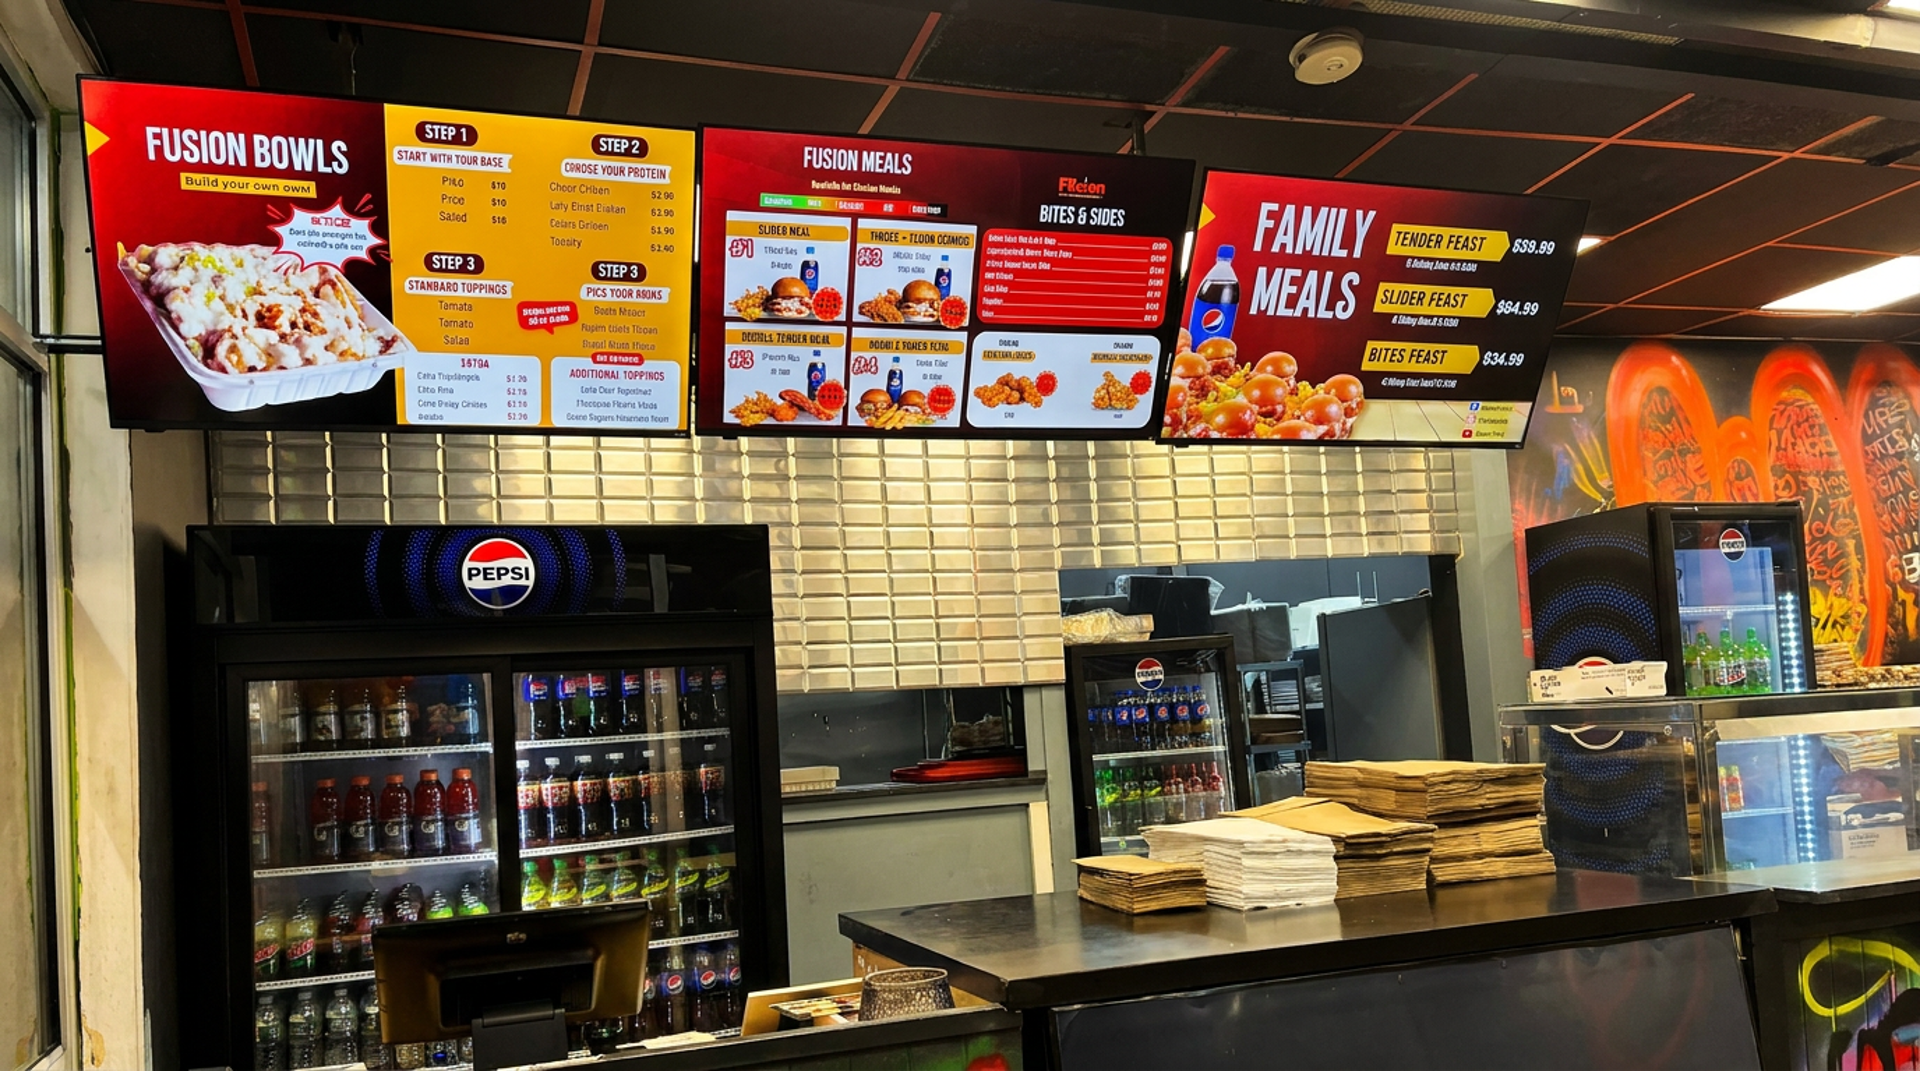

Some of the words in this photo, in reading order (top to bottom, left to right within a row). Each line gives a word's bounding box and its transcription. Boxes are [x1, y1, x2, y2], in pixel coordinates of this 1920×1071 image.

[425, 124, 456, 140] STEP
[460, 128, 466, 141] 1
[146, 126, 247, 167] FUSION
[253, 134, 349, 174] BOWLS
[600, 137, 629, 153] STEP
[631, 140, 640, 154] 2
[398, 150, 427, 162] START
[430, 153, 452, 163] WITH
[481, 156, 503, 168] BASE
[804, 146, 858, 170] FUSION
[862, 151, 912, 175] MEALS
[601, 165, 625, 176] YOUR
[185, 176, 218, 188] Build
[222, 179, 250, 190] your
[254, 182, 280, 192] own
[1040, 204, 1074, 224] BITES
[1078, 208, 1086, 224] &
[1090, 208, 1125, 226] SIDES
[1252, 202, 1376, 259] FAMILY
[1394, 231, 1444, 249] TENDER
[1446, 234, 1487, 252] FEAST
[432, 255, 463, 270] STEP
[466, 257, 475, 270] 3
[598, 263, 628, 278] STEP
[630, 265, 638, 278] 3
[1249, 266, 1362, 320] MEALS
[1380, 289, 1426, 306] SLIDER
[1428, 292, 1468, 308] FEAST
[1368, 347, 1406, 363] BITES
[1408, 349, 1448, 365] FEAST
[467, 567, 529, 580] PEPSI
